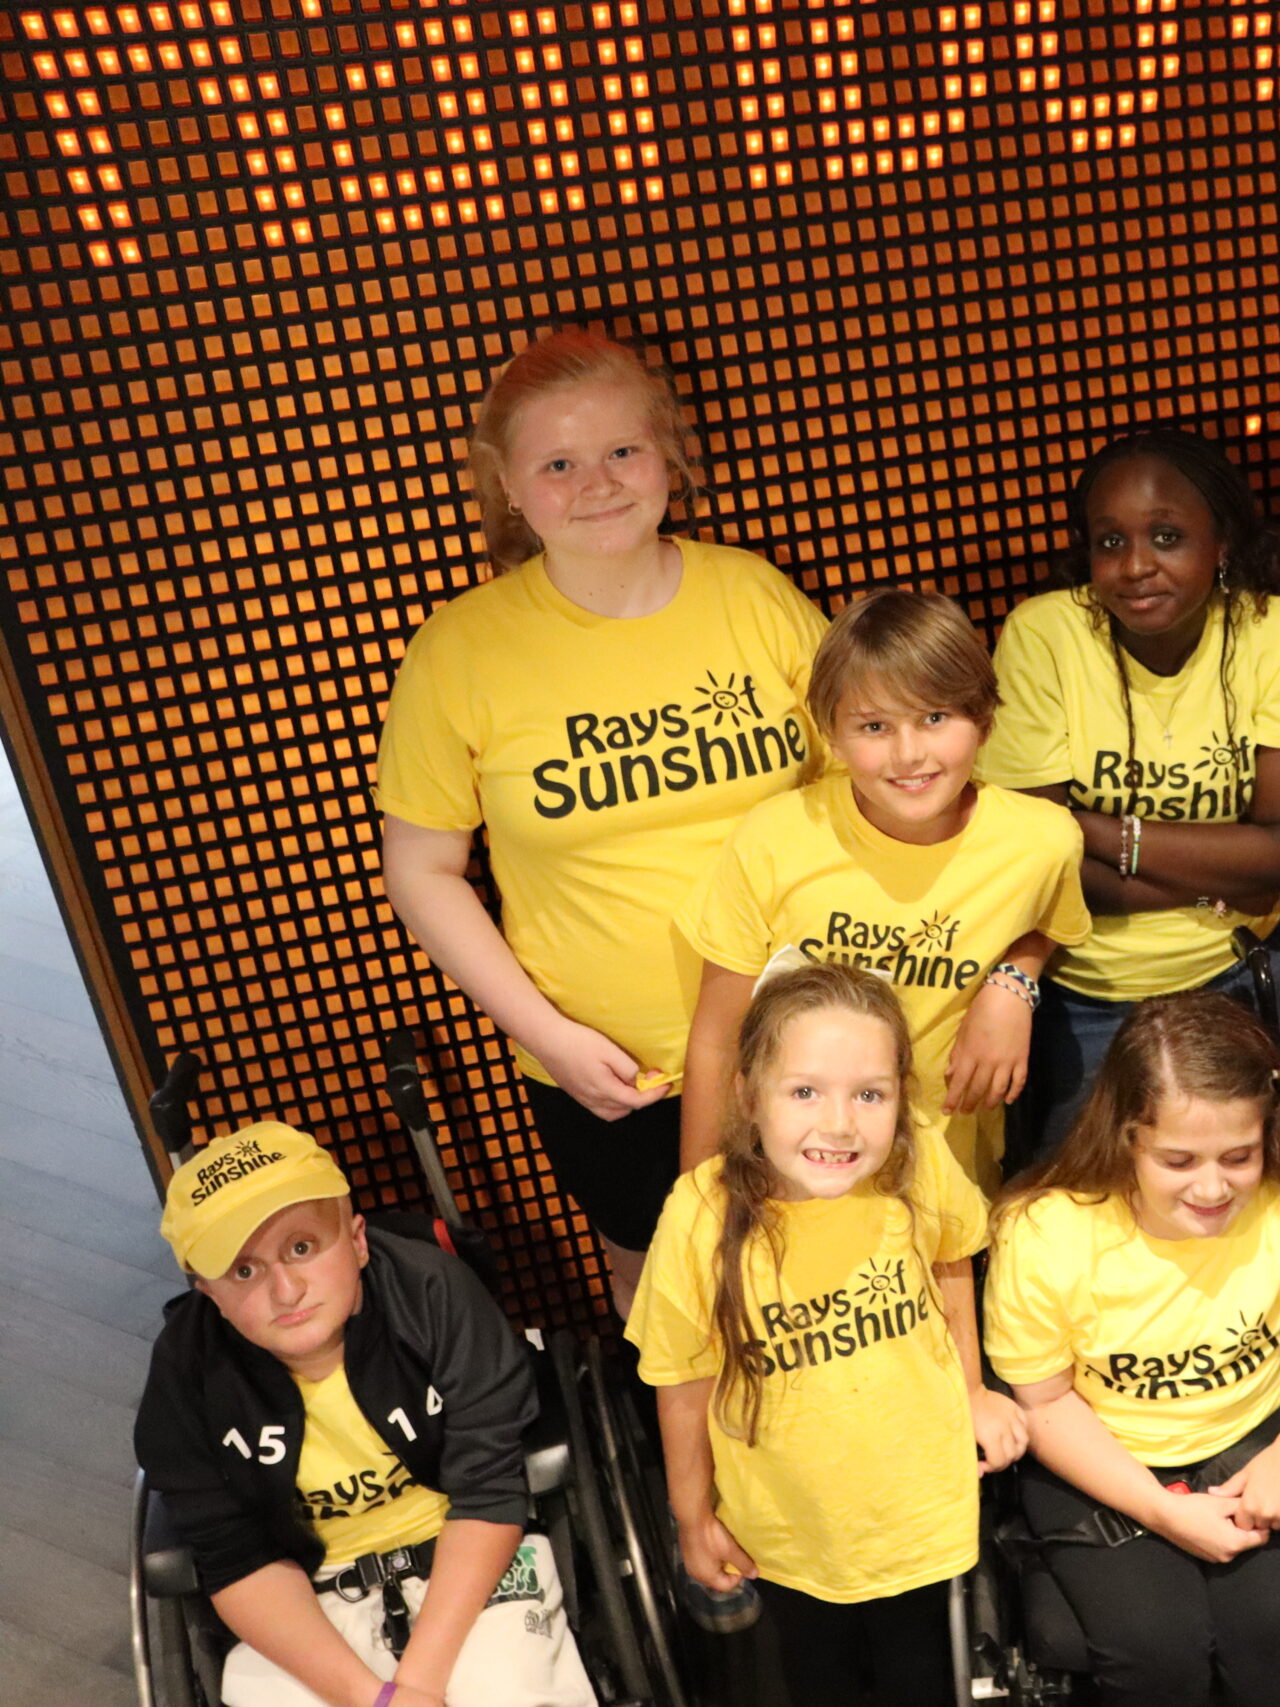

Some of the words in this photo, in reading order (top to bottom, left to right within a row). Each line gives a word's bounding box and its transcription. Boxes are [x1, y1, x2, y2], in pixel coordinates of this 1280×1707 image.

[566, 704, 689, 759] Rays
[533, 716, 806, 818] Sunshine
[1093, 750, 1190, 789] Rays
[827, 911, 905, 950] Rays
[191, 1151, 286, 1207] Sunshine
[197, 1152, 235, 1185] Rays
[762, 1289, 851, 1338] Rays
[1109, 1344, 1215, 1382] Rays
[296, 1470, 385, 1505] ays
